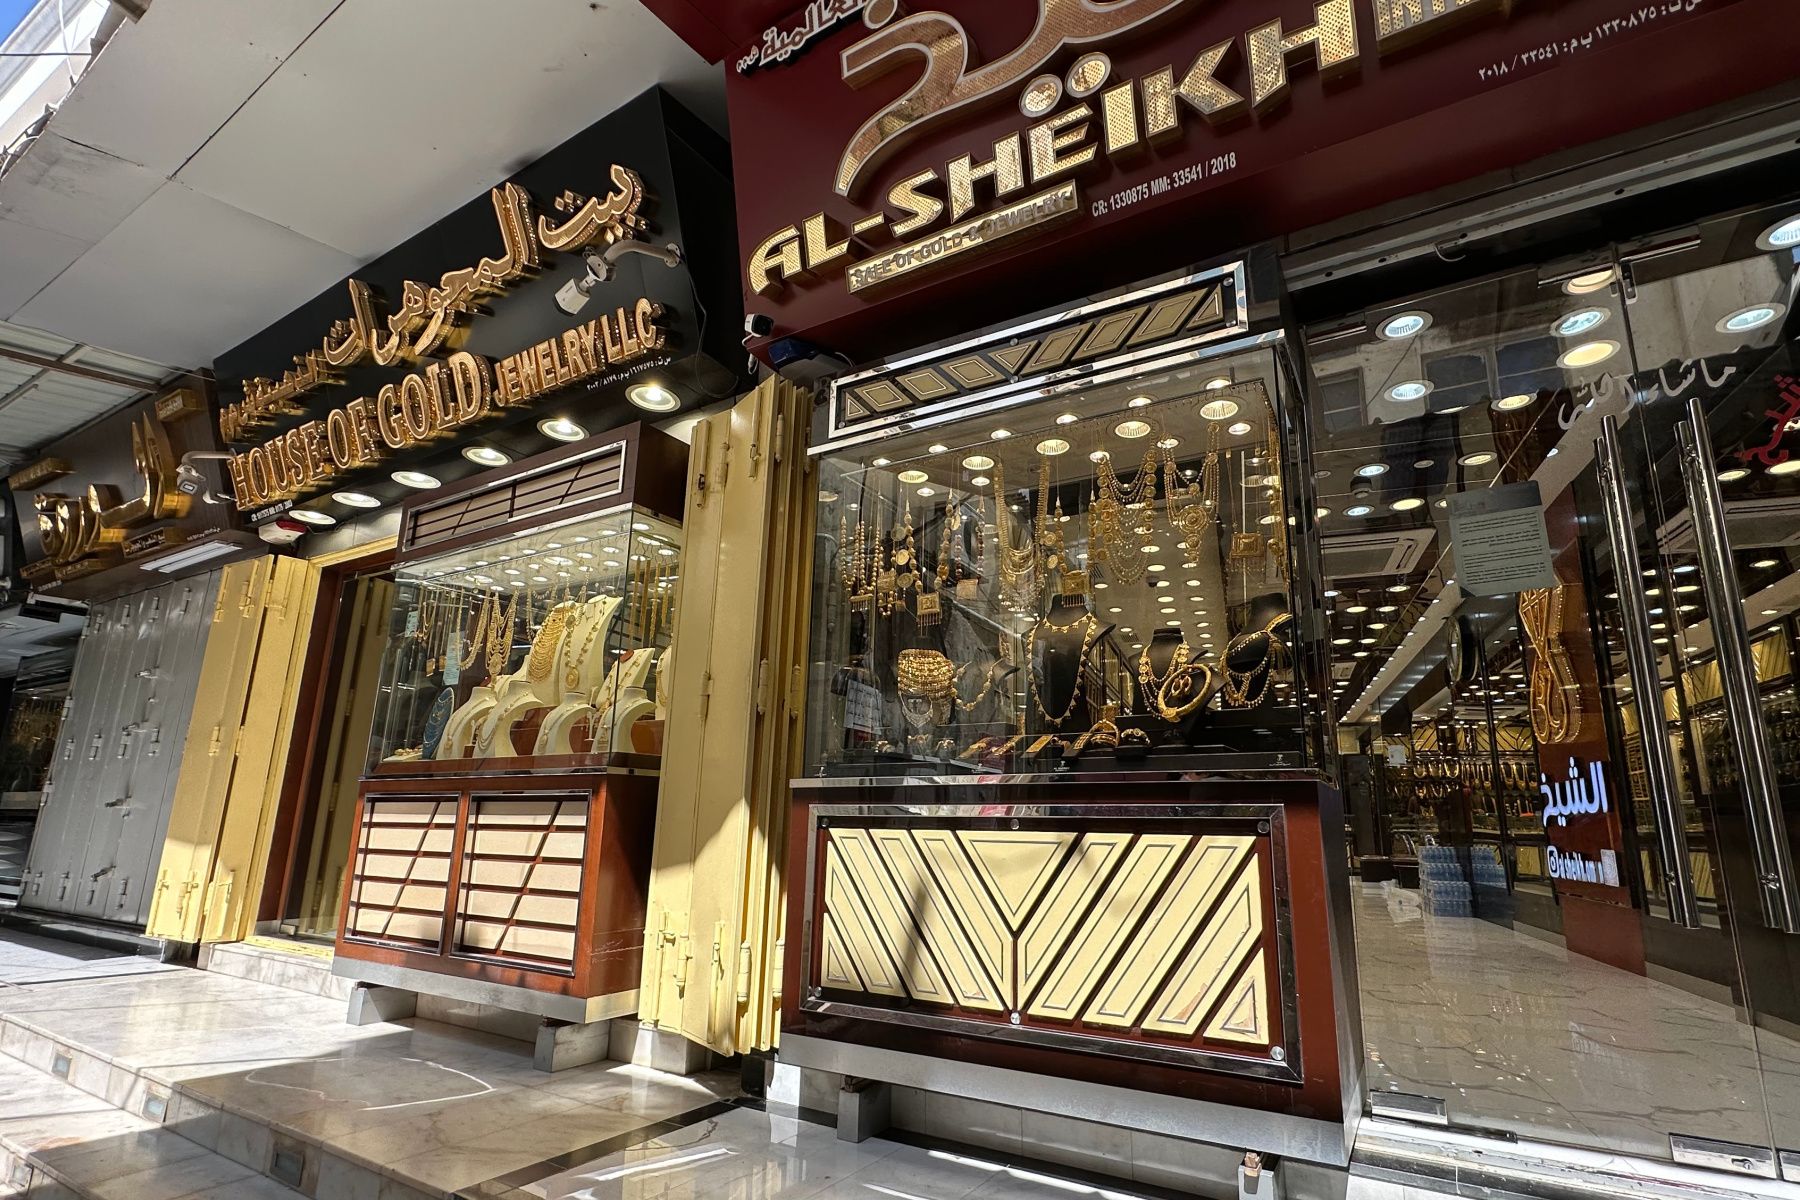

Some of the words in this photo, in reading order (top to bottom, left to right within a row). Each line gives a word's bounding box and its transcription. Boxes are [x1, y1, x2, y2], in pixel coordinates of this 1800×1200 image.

[1521, 41, 1559, 66] ٣٣٥٤١
[1595, 5, 1657, 39] ١٣٣٠٨٧٥
[1478, 61, 1509, 81] ٢٠١٨
[538, 164, 634, 250] بيت
[1092, 199, 1108, 217] CR:
[1110, 183, 1149, 211] 1330875
[1151, 175, 1171, 196] MM:
[1173, 163, 1202, 188] 33541
[1211, 151, 1237, 175] 2018
[324, 182, 534, 366] المجوهرات
[853, 258, 892, 285] SALE
[896, 250, 915, 269] OF
[919, 232, 963, 259] GOLD
[968, 226, 981, 241] &
[986, 191, 1069, 235] JEWELRY
[227, 420, 324, 510] HOUSE
[328, 397, 375, 469] OF
[377, 350, 486, 450] GOLD
[493, 320, 599, 408] JEWELRY
[598, 297, 656, 363] LLC
[1540, 756, 1608, 828] الشيخ
